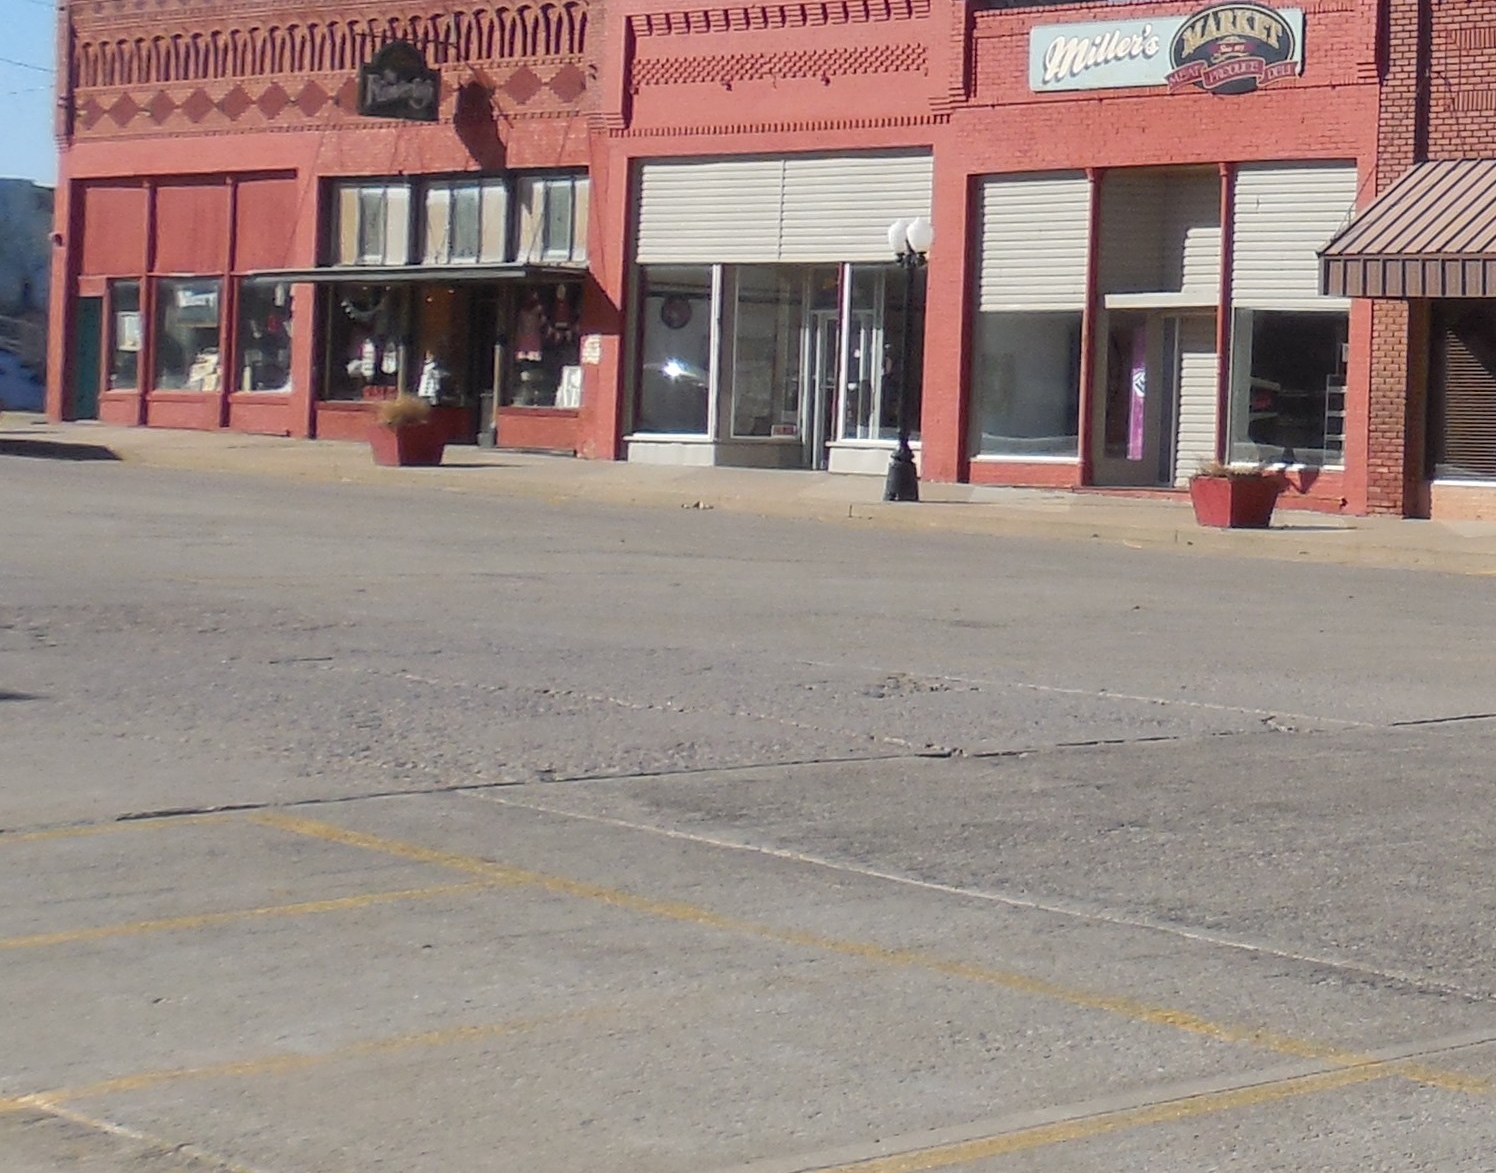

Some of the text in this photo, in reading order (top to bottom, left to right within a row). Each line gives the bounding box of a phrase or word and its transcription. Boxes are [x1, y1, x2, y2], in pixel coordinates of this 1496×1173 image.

[1043, 23, 1159, 84] Miller's
[1181, 8, 1282, 58] MARKET
[1168, 65, 1200, 86] MEAT
[1267, 65, 1292, 80] DELI
